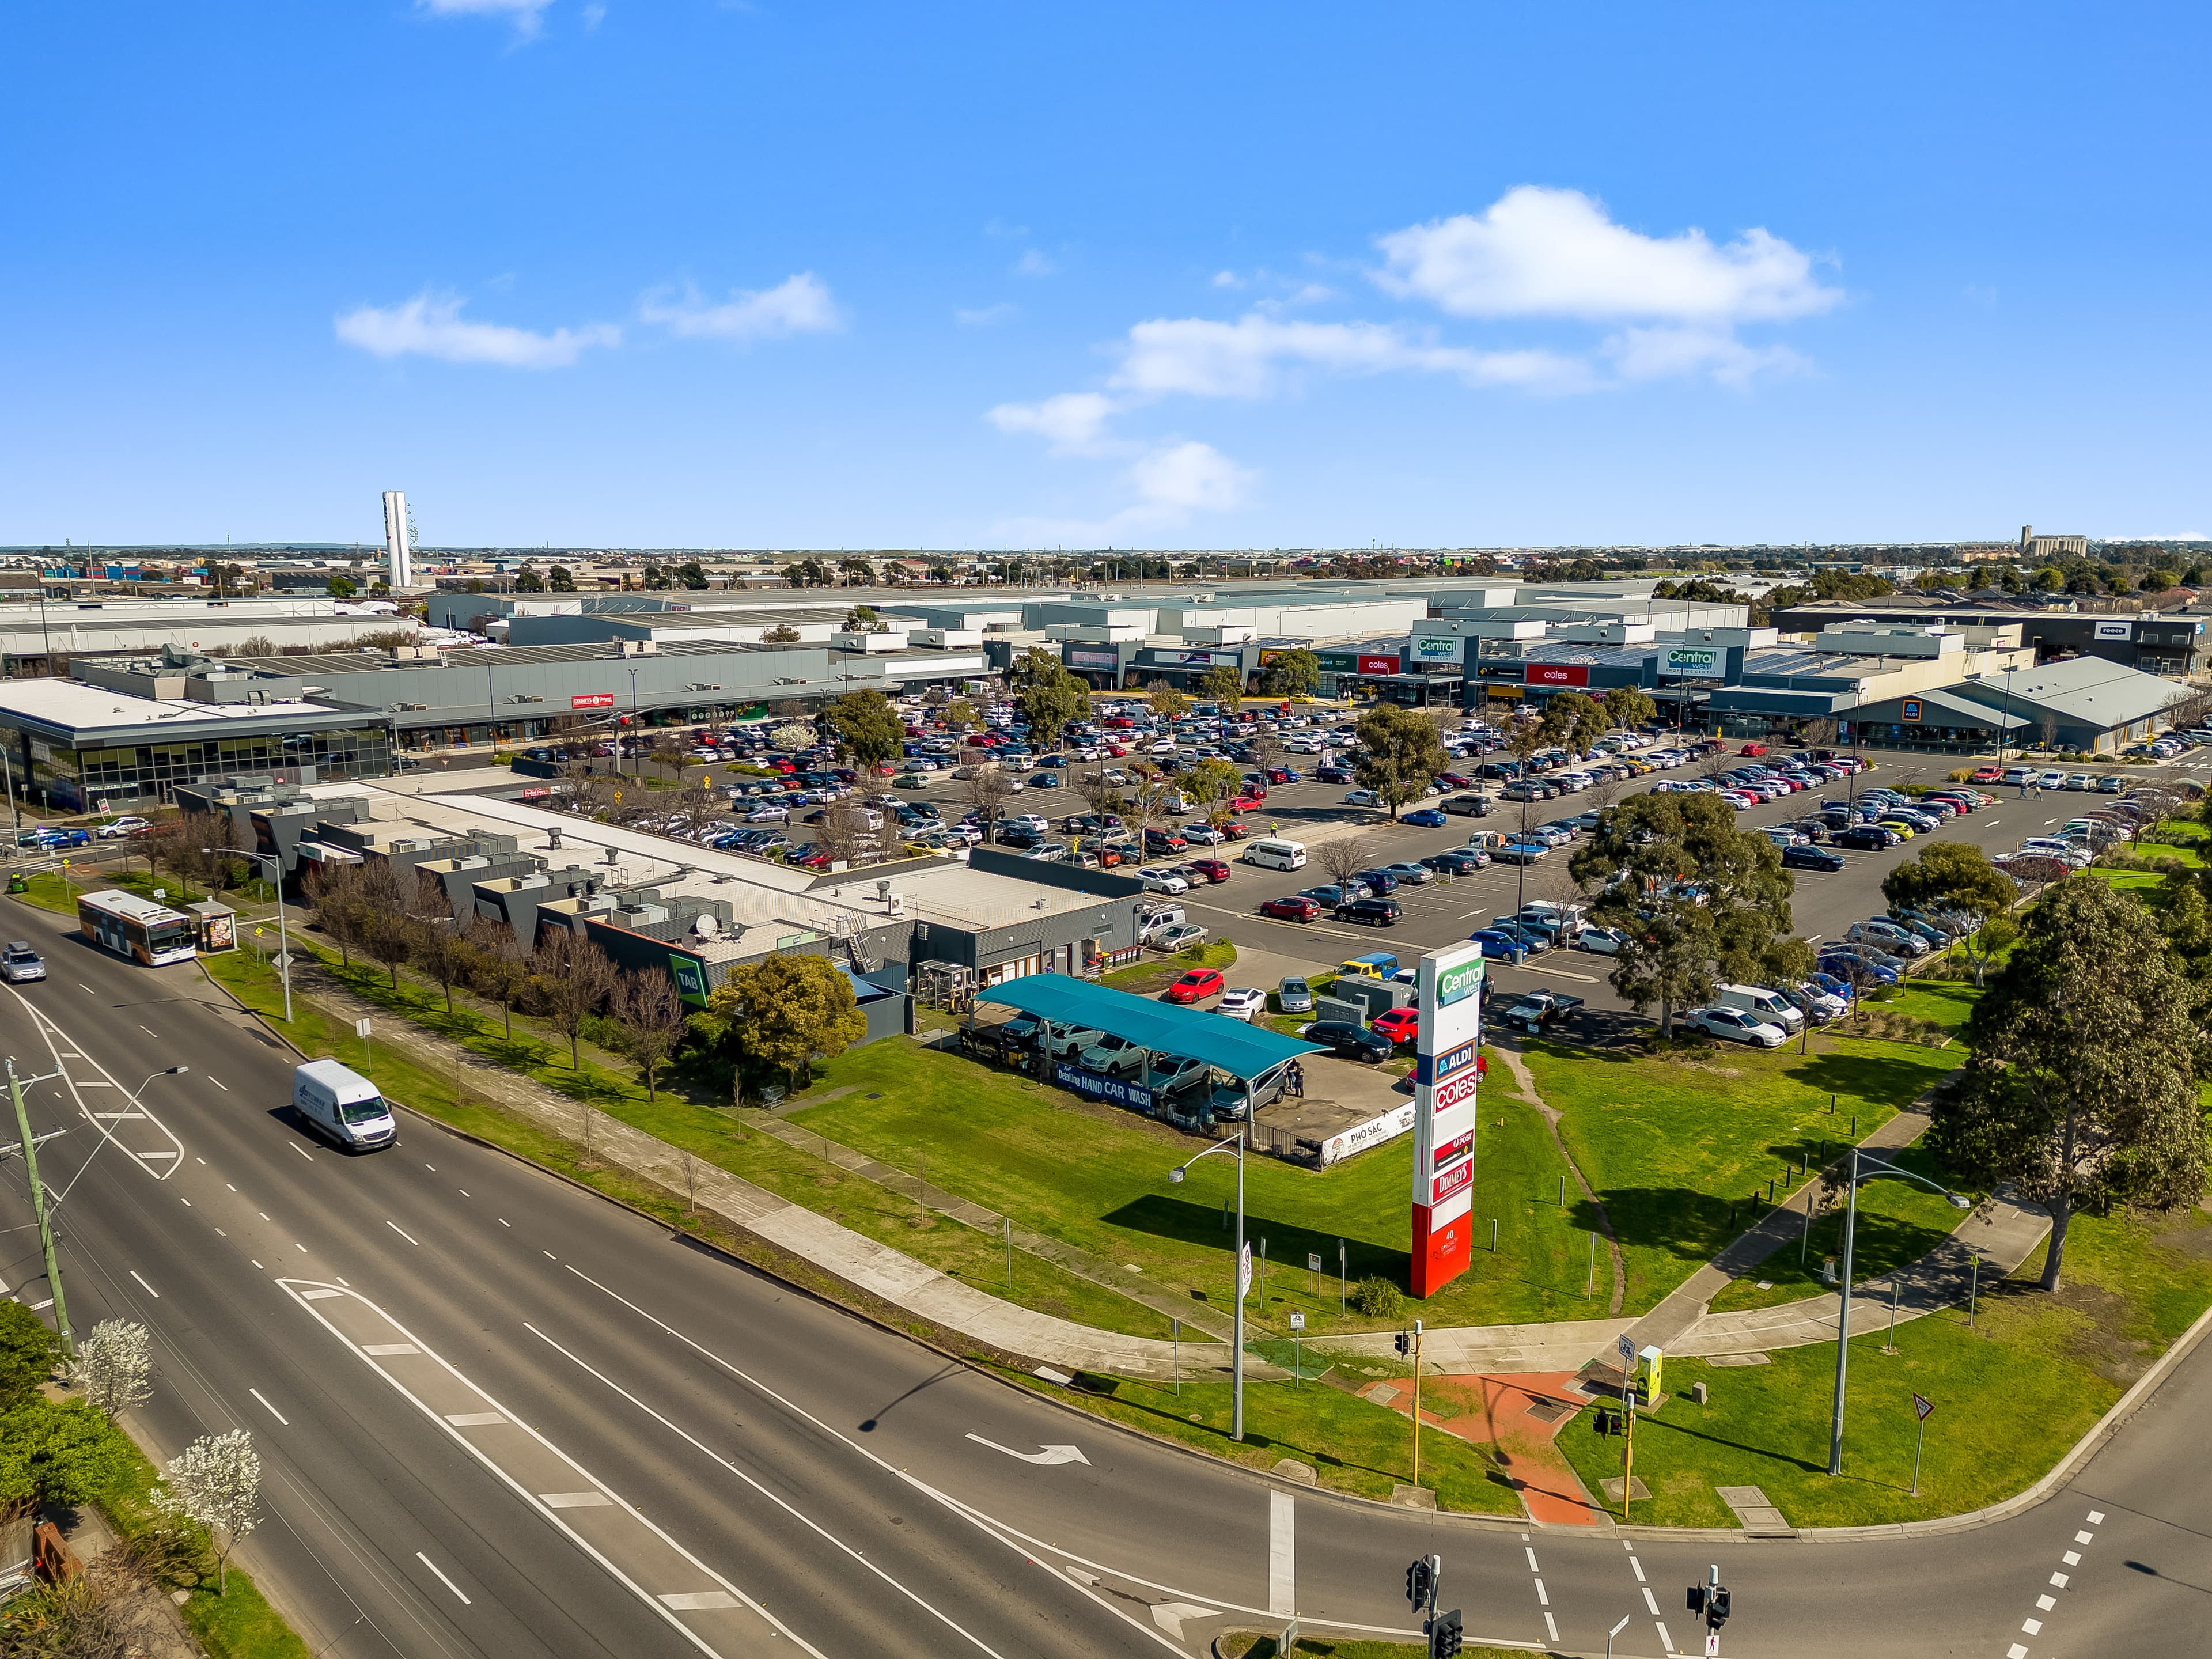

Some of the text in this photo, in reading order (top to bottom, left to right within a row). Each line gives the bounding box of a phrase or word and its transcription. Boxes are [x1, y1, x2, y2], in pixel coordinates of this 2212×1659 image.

[1418, 639, 1456, 652] Central
[1668, 650, 1715, 664] Central
[1368, 660, 1388, 669] coles
[1544, 670, 1567, 680] coles
[678, 972, 698, 990] TAB
[1442, 961, 1484, 994] Central
[1464, 982, 1480, 995] west
[1449, 1047, 1472, 1070] ALDI
[1058, 1069, 1151, 1107] Detailing HAND CAR WASH
[1436, 1075, 1475, 1109] coles
[1459, 1132, 1472, 1146] POST
[1446, 1229, 1454, 1240] 40
